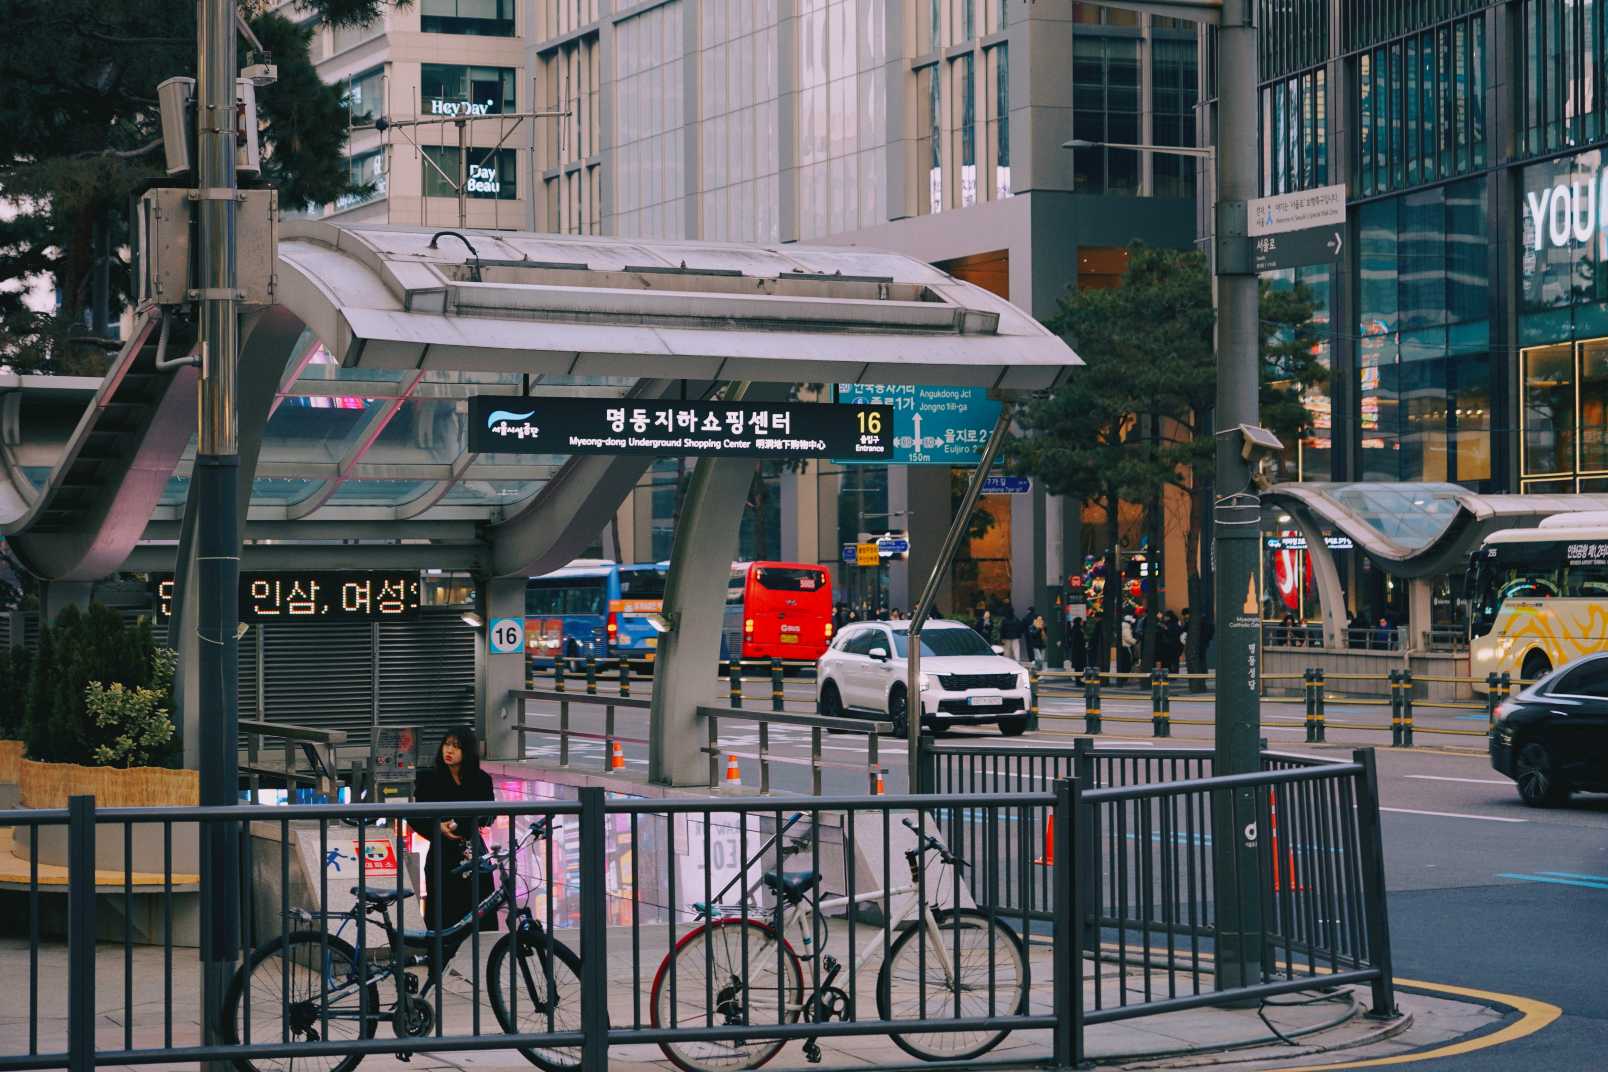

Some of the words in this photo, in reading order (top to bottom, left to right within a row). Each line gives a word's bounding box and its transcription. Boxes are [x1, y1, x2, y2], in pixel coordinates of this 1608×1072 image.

[467, 178, 500, 193] Beau
[919, 389, 959, 399] Angukdong
[919, 402, 945, 413] Jongno
[856, 411, 882, 434] 16
[569, 436, 627, 448] Myeong-dong
[628, 437, 682, 449] Underground
[683, 438, 722, 450] Shopping
[723, 439, 751, 449] Center
[859, 435, 880, 445] 출입구
[855, 444, 885, 453] Entrance
[908, 453, 931, 462] 150m
[251, 580, 328, 615] 인삼,
[342, 579, 418, 614] 여성
[494, 626, 518, 647] 16
